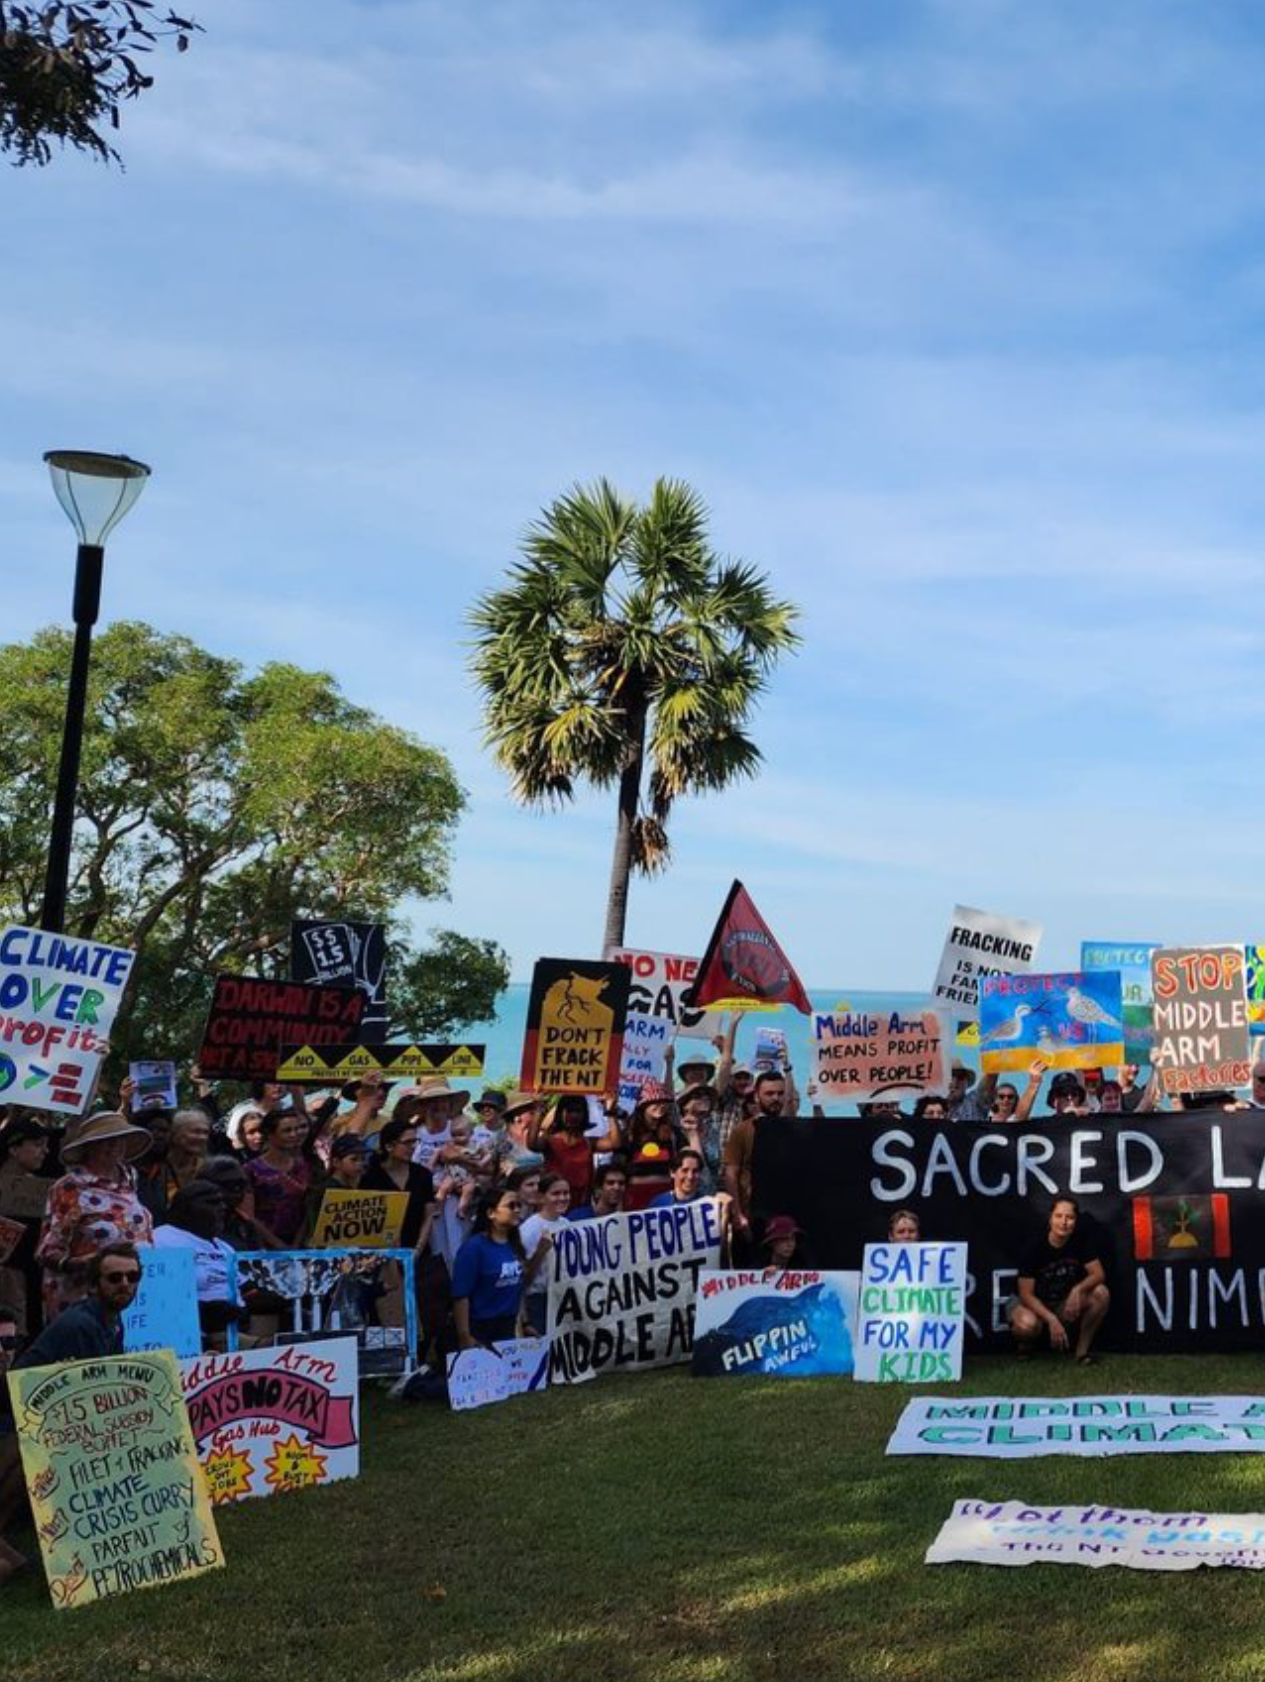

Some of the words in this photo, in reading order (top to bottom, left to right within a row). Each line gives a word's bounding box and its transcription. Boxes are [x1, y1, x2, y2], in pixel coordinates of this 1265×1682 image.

[0, 930, 132, 986] CLIMATE
[951, 926, 1033, 962] FRACKING
[957, 960, 973, 974] IS
[1155, 953, 1242, 997] STOP
[0, 973, 104, 1025] OVER
[215, 980, 312, 1016] DARWIN
[320, 991, 341, 1018] IS
[983, 971, 1086, 996] PROTECT
[816, 1014, 878, 1039] Middle
[888, 1012, 926, 1036] Arm
[1154, 1001, 1245, 1031] MIDDLE
[545, 1027, 606, 1045] DON'T
[818, 1043, 878, 1059] MEANS
[888, 1039, 941, 1056] PROFIT
[1156, 1035, 1220, 1067] ARM
[294, 1054, 315, 1066] NO
[350, 1055, 370, 1066] GAS
[542, 1047, 604, 1066] FRACK
[627, 1059, 651, 1072] FOR
[818, 1069, 861, 1083] OVER
[869, 1061, 934, 1081] PEOPLE!
[540, 1068, 573, 1086] THE
[576, 1069, 603, 1087] NT
[870, 1128, 1166, 1202] SACRED
[324, 1197, 385, 1214] CLIMATE
[331, 1206, 388, 1224] ACTION
[323, 1218, 386, 1242] NOW
[551, 1218, 622, 1283] YOUNG
[628, 1202, 721, 1264] PEOPLE
[868, 1246, 957, 1284] SAFE
[556, 1257, 707, 1326] AGAINST
[701, 1270, 774, 1299] MIDDLE
[776, 1270, 821, 1290] ARM
[862, 1286, 962, 1315] CLIMATE
[550, 1314, 655, 1379] MIDDLE
[721, 1320, 807, 1371] FLIPPIN
[864, 1321, 909, 1348] FOR
[919, 1321, 957, 1350] MY
[764, 1336, 817, 1372] AWFUL
[878, 1353, 953, 1381] KIDS
[179, 1354, 243, 1394] iddle
[274, 1347, 338, 1383] Arm
[30, 1374, 71, 1410] MIDDLE
[81, 1364, 107, 1381] ARM
[117, 1364, 156, 1383] MENU
[93, 1387, 149, 1415] BILLION
[188, 1382, 241, 1430] PAYS
[242, 1375, 283, 1410] NO
[286, 1379, 326, 1426] TAX
[925, 1401, 1219, 1420] MIDDLE
[43, 1421, 103, 1448] FEDERAL
[103, 1407, 154, 1433] SUBSIDY
[212, 1424, 245, 1452] Gas
[249, 1418, 281, 1437] Hub
[69, 1453, 112, 1491] FILET
[68, 1473, 150, 1514] CLIMATE
[73, 1500, 138, 1540] CRISIS
[141, 1477, 194, 1516] CURRY
[1079, 1508, 1208, 1528] them
[92, 1521, 161, 1563] PARFAIT
[1079, 1542, 1127, 1554] NT
[91, 1537, 218, 1598] PETROCHEMICALS
